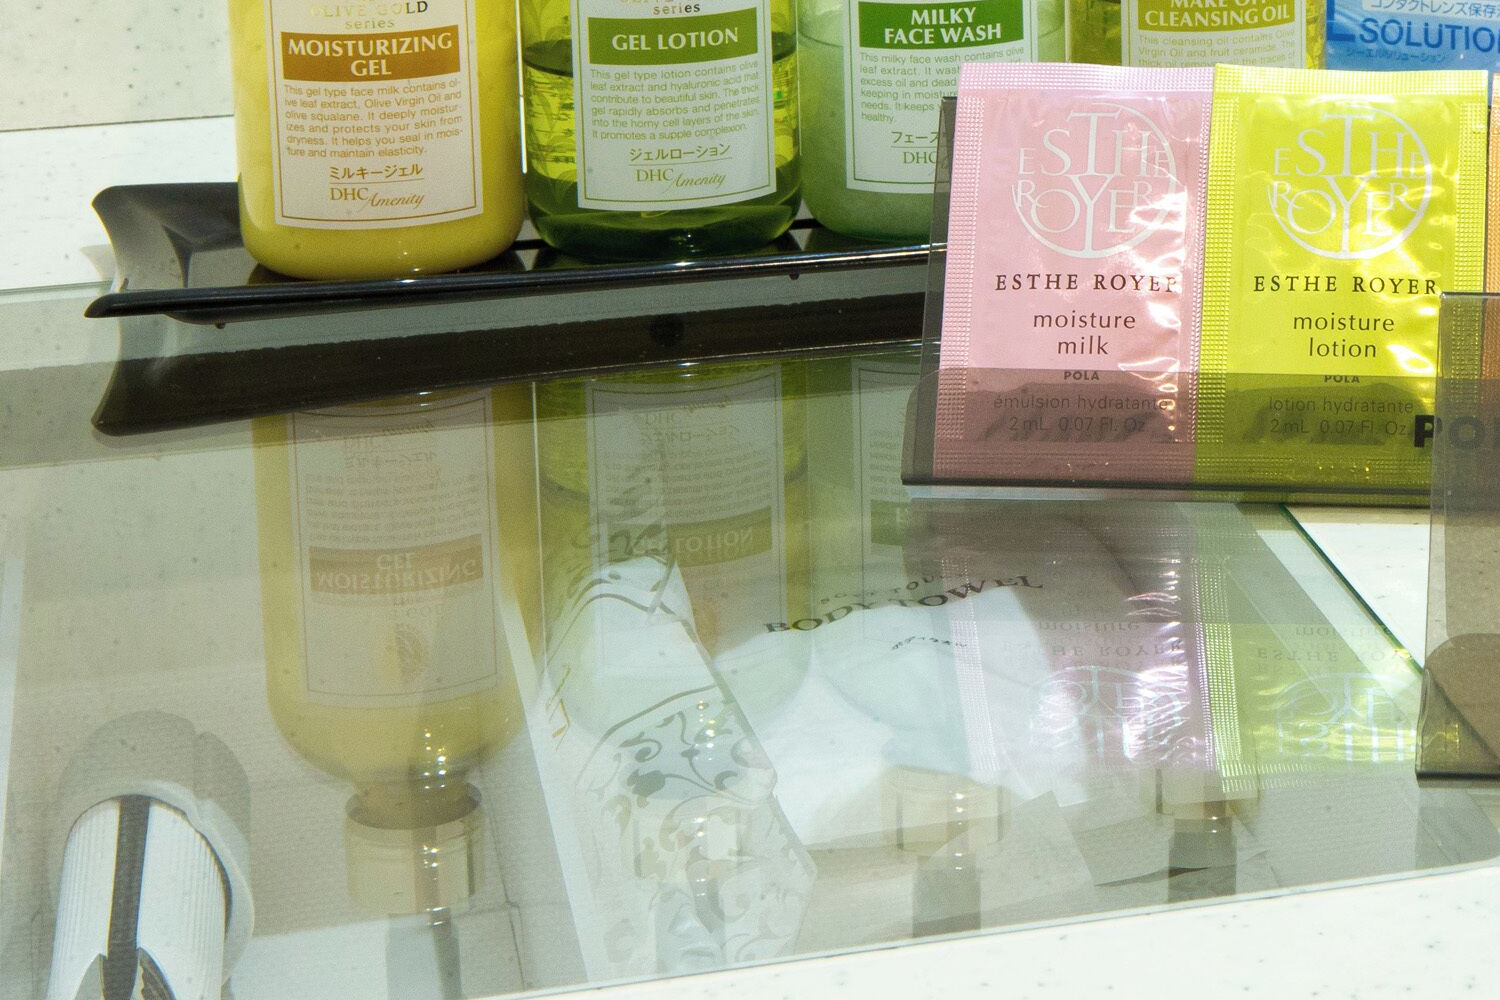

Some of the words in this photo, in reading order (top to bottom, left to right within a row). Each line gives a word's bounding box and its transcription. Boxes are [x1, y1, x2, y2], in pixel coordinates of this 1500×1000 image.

[653, 3, 701, 15] series
[910, 6, 977, 26] MILKY
[1144, 8, 1259, 28] CLEANSING
[1262, 4, 1291, 23] OIL
[345, 19, 395, 30] series
[884, 27, 935, 45] FACE
[939, 22, 1002, 44] WASH
[288, 32, 453, 57] MOISTURIZING
[611, 34, 651, 51] GEL
[657, 27, 739, 50] LOTION
[860, 51, 879, 63] This
[881, 53, 906, 65] milky
[909, 54, 931, 65] face
[934, 53, 961, 64] wash
[964, 49, 1004, 62] contains
[350, 58, 392, 76] GEL
[285, 110, 308, 121] olive
[379, 109, 416, 121] deeply
[629, 143, 731, 162] ジェルローション
[329, 163, 424, 180] ミルキージェル
[636, 168, 674, 182] DHC
[672, 173, 727, 190] Amenity
[330, 187, 369, 201] DHC
[367, 192, 425, 210] Amenity
[995, 272, 1079, 291] ESTHE
[1253, 274, 1338, 293] ESTHE
[1352, 275, 1438, 296] ROYER
[1032, 308, 1137, 330] moisture
[1292, 311, 1396, 333] moisture
[1057, 334, 1110, 356] milk
[1308, 336, 1378, 360] lotion
[1063, 371, 1100, 382] POLA
[1077, 394, 1169, 412] hydratante
[1269, 397, 1316, 413] lotion
[1323, 397, 1414, 414] hydratante
[1009, 417, 1018, 432] 2
[1023, 417, 1049, 432] mL
[1057, 417, 1095, 432] 0.07
[1269, 419, 1280, 434] 2
[1283, 419, 1310, 434] mL
[1319, 419, 1355, 434] 0.07
[763, 601, 873, 633] BODY
[887, 574, 1044, 608] TOWEL
